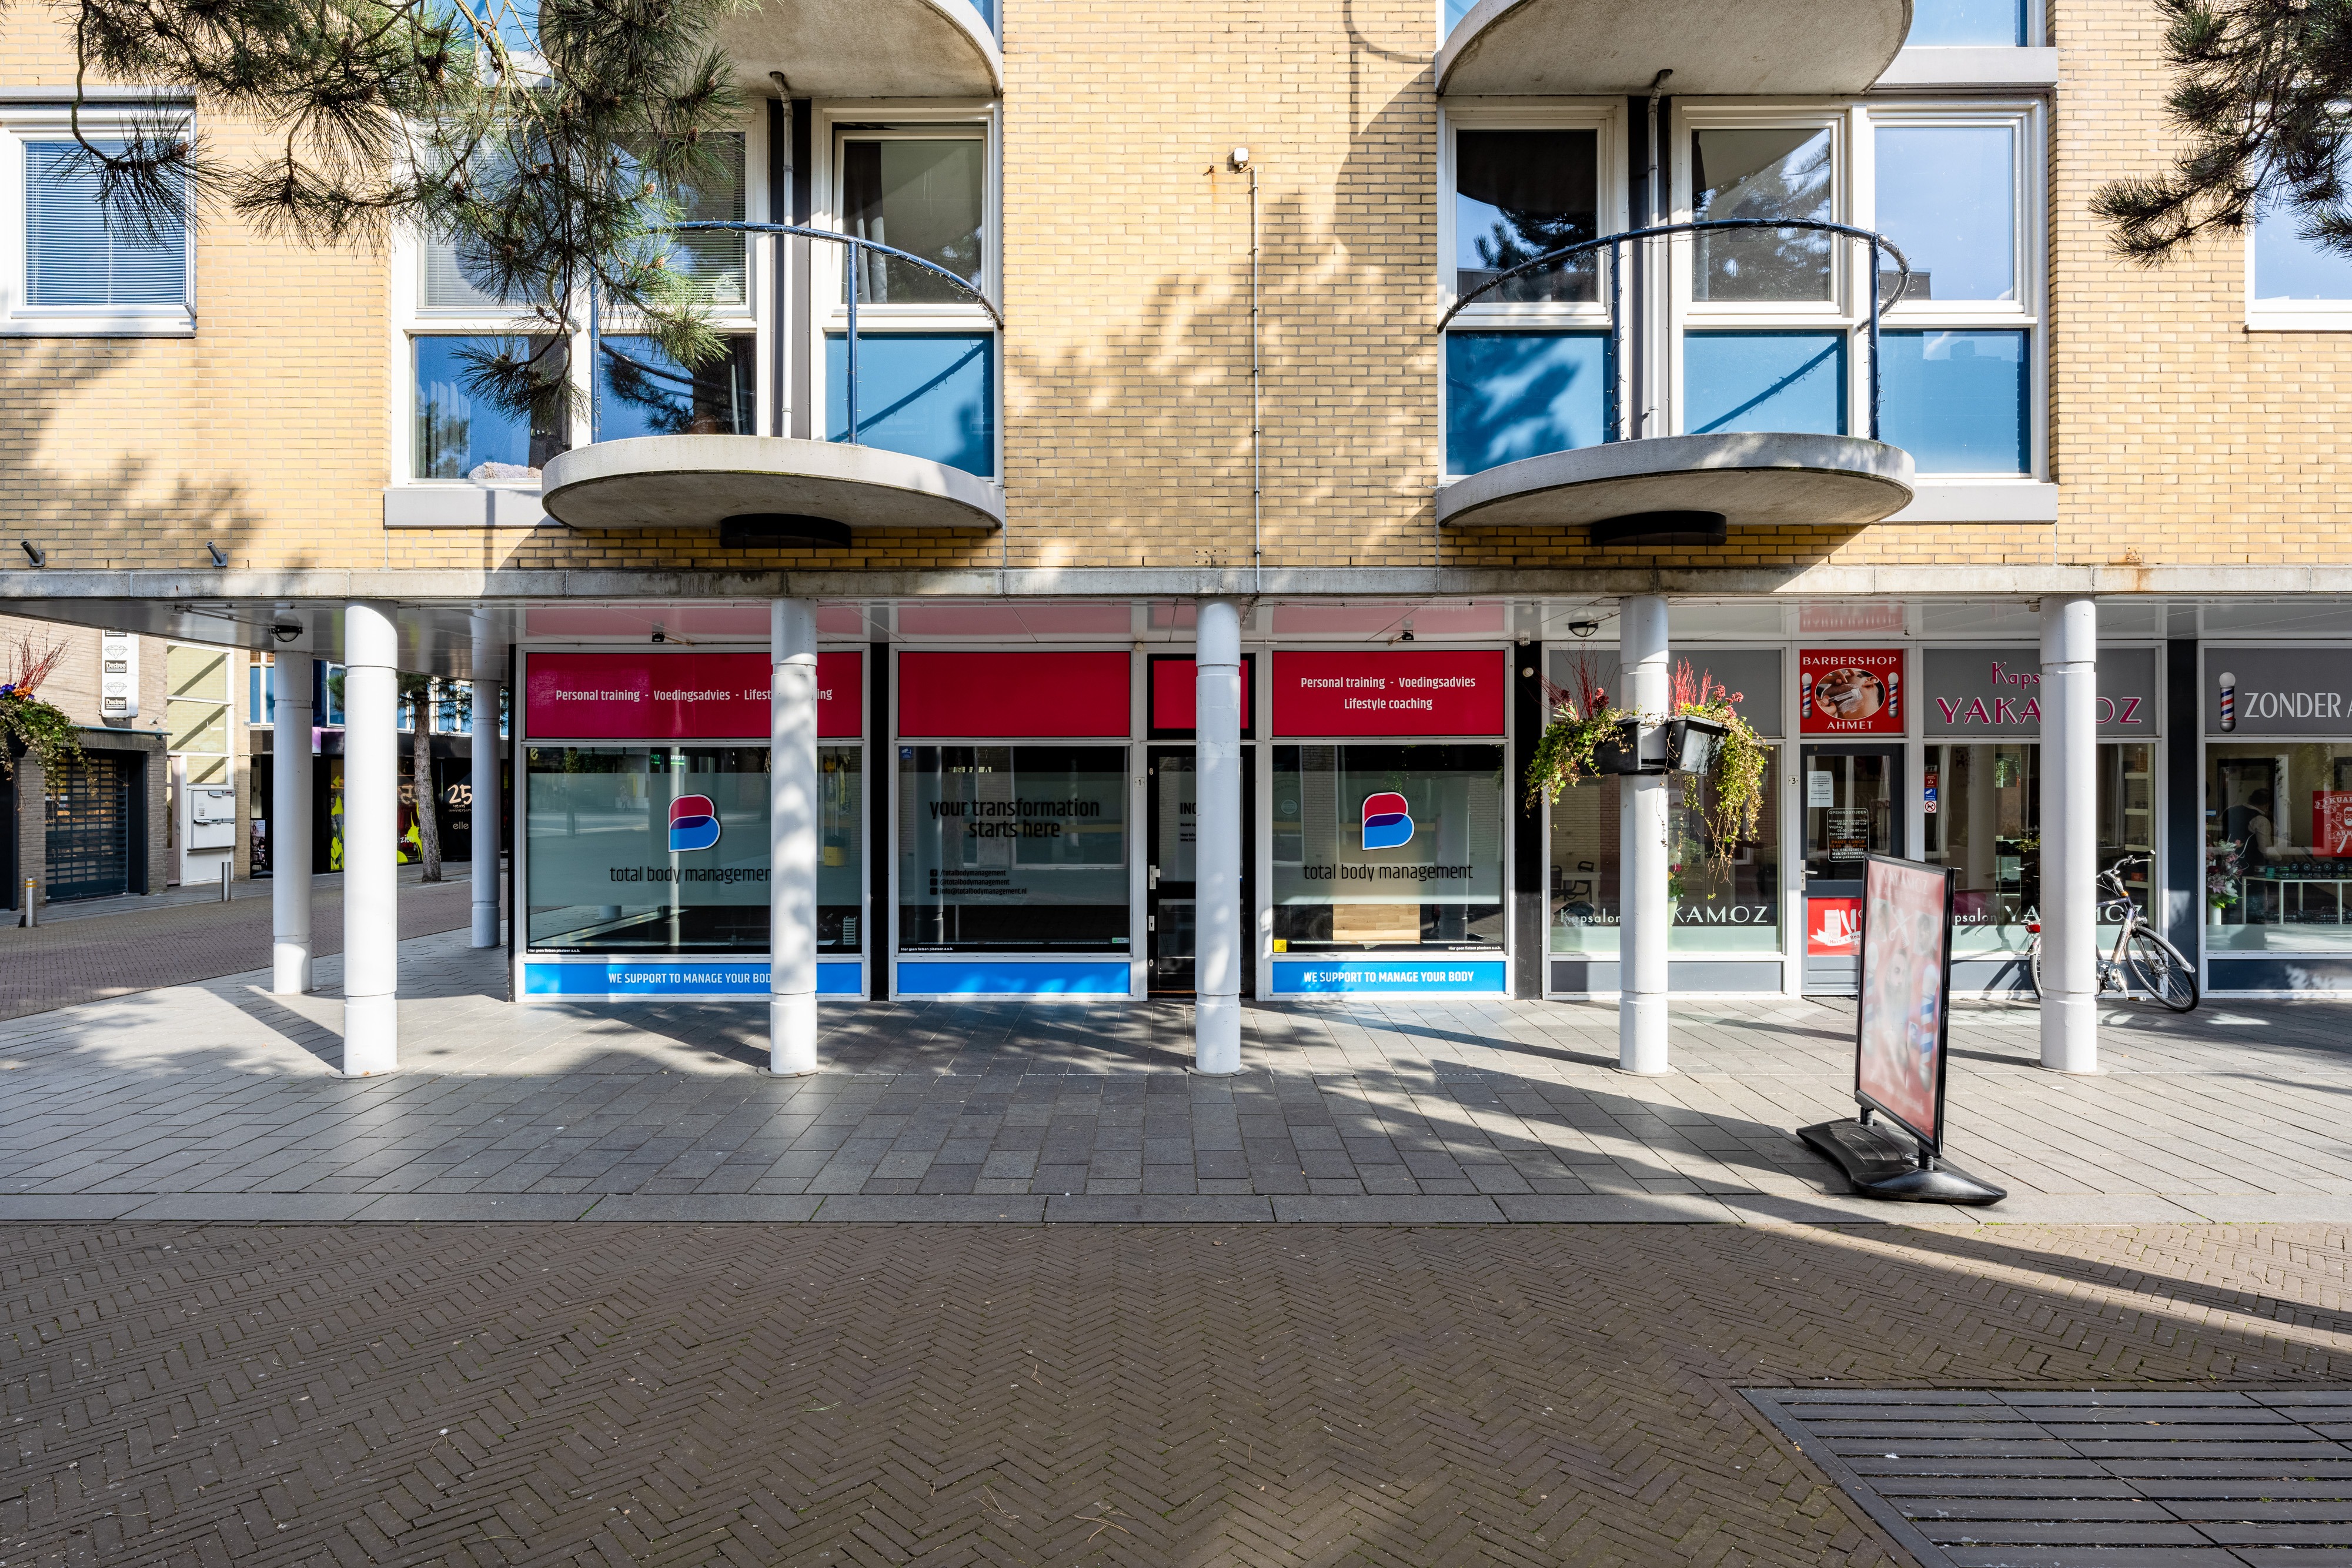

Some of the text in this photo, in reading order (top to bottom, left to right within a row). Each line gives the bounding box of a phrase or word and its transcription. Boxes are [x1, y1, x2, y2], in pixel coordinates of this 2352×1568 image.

[1803, 656, 1897, 665] BARBERSHOP
[1301, 677, 1343, 688] Personal
[1346, 677, 1385, 689] training
[1399, 677, 1475, 689] Voedingsadvies
[1992, 662, 2040, 690] Kaps
[556, 690, 597, 700] Personal
[601, 690, 640, 702] training
[653, 689, 730, 702] Voedingsadvies
[744, 689, 771, 700] Lifest
[1344, 698, 1432, 710] Lifestyle coaching
[1936, 697, 2142, 724] YAKAOZ
[2244, 692, 2341, 718] ZONDER
[1827, 721, 1873, 729] AHMET
[447, 784, 472, 804] 25
[929, 800, 968, 819] your
[972, 798, 1100, 817] transformation
[453, 821, 469, 830] elle
[969, 820, 1060, 838] starts here
[610, 866, 771, 884] total body managemen
[940, 869, 1006, 877] /totalbodymanagement
[1304, 864, 1473, 881] total body management
[940, 878, 1010, 887] @totalbodymanagement
[1673, 906, 1768, 923] KAMOZ
[1954, 907, 1997, 925] psalon
[609, 973, 771, 983] WE SUPPORT TO MANAGE YOUR BOD
[1304, 971, 1474, 982] WE SUPPORT TO MANAGE YOUR BODY
